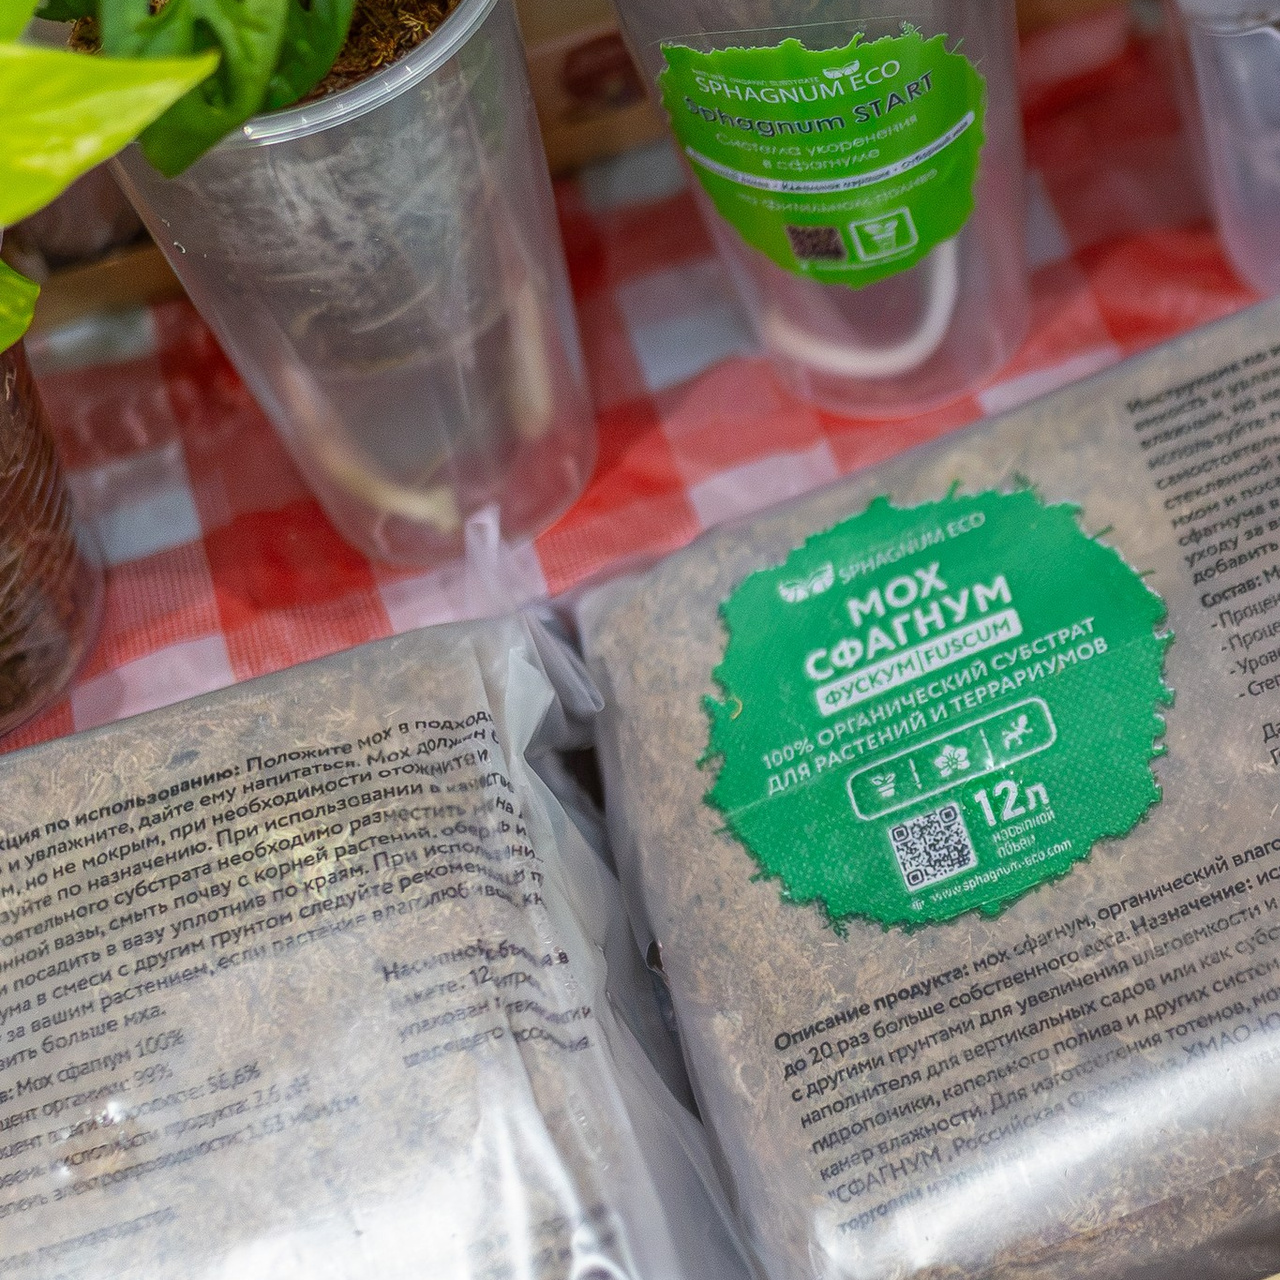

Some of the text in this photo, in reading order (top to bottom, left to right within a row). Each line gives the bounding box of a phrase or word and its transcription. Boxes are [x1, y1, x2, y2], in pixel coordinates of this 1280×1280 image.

[683, 70, 933, 137] Sphagnum START
[694, 60, 901, 104] SPHAGNUM ECO
[838, 510, 988, 583] SPHAGNUM ECO
[1194, 538, 1279, 584] добавить
[1241, 523, 1262, 540] за
[800, 573, 1013, 684] СФАГНУМ
[845, 563, 948, 626] МОХ
[1198, 575, 1262, 609] Состав:
[760, 616, 1098, 769] 100% ОРГАНИЧЕСКИЙ СУБСТРАТ
[824, 619, 1011, 705] ФУСКУМ FUSCUM
[767, 635, 1109, 792] ДЛЯ РАСТЕНИЙ И ТЕРРАРИУМОВ
[25, 744, 409, 868] увлажните, дайте ему напитаться. Мох
[73, 724, 392, 826] использованию: Положите мох
[973, 778, 1051, 828] 12л
[80, 769, 373, 869] мокрым, при необходимости
[86, 781, 424, 890] назначению. При использовании
[107, 845, 328, 930] смыть почву корней
[112, 822, 344, 906] субстрата необходимо
[50, 880, 395, 999] смеси другим грунтом следуйте
[770, 1001, 871, 1052] Описание
[872, 963, 969, 1011] продукта:
[971, 947, 1009, 972] мох
[1096, 854, 1229, 923] органический
[779, 1056, 808, 1080] до
[806, 1040, 835, 1065] 20
[835, 1030, 869, 1058] раз
[871, 999, 945, 1039] больше
[946, 947, 1079, 1010] собственного
[1129, 876, 1254, 936] Назначение:
[789, 1087, 803, 1102] с
[803, 1053, 885, 1100] другими
[887, 1018, 975, 1064] грунтами
[810, 1093, 942, 1153] гидропоники,
